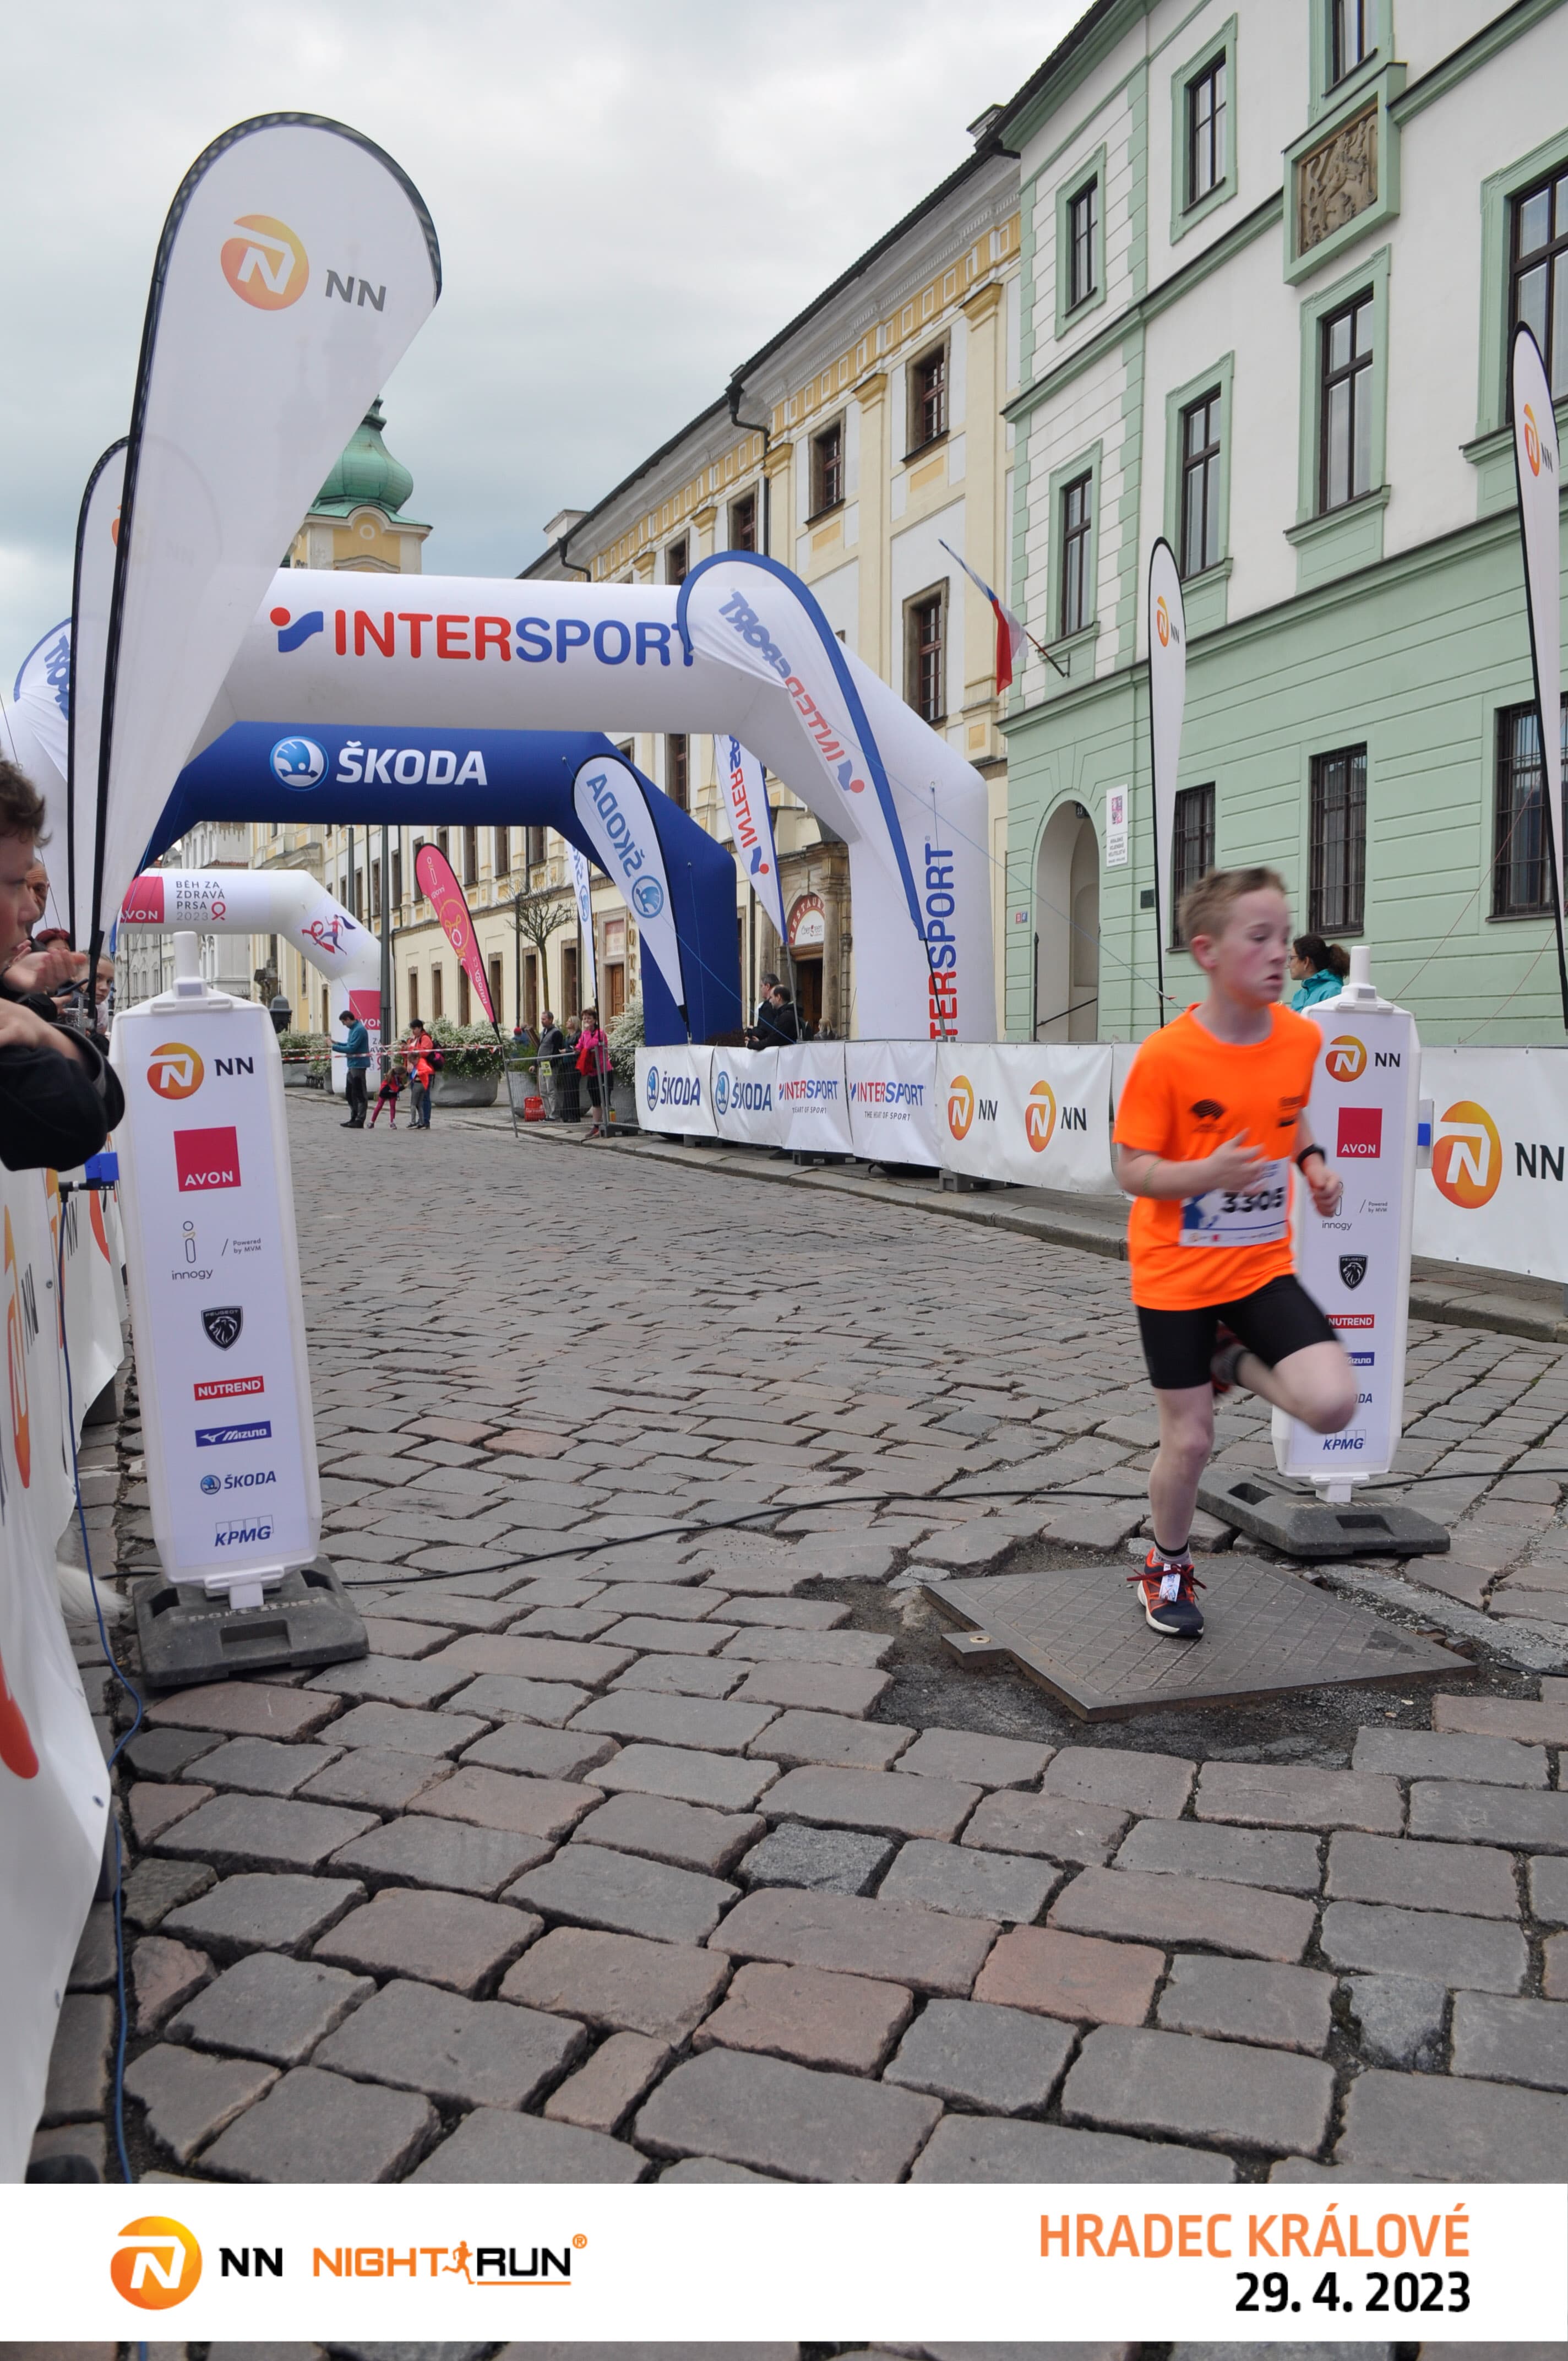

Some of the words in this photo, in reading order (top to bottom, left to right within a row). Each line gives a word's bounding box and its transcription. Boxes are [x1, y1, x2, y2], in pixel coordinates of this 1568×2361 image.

[325, 269, 387, 312] NN
[335, 739, 488, 786] ŠKODA
[176, 880, 199, 889] BĚH
[176, 889, 225, 899] ZDRAVÁ
[177, 901, 207, 910] PRSA
[176, 912, 208, 921] 2023
[925, 842, 959, 1039] TERSPORT
[214, 1057, 254, 1076] NN
[1374, 1052, 1401, 1068] NN
[660, 1071, 701, 1106] ŠKODA
[731, 1076, 772, 1112] ŠKODA
[785, 1080, 838, 1100] INTERSPORT
[857, 1081, 924, 1106] INTERSPORT
[890, 1112, 911, 1121] SPORT
[978, 1099, 998, 1121] NN
[1061, 1106, 1087, 1131] NN
[1341, 1144, 1376, 1154] AVON
[1515, 1141, 1565, 1182] NN
[185, 1171, 233, 1187] AVON
[1322, 1220, 1352, 1231] innogy
[233, 1238, 262, 1246] Powered
[172, 1269, 213, 1281] innogy
[205, 1309, 239, 1317] PEUGEOT
[1329, 1317, 1373, 1326] NUTREND
[198, 1379, 261, 1397] NUTREND
[1322, 1438, 1364, 1450] KPMG
[224, 1470, 276, 1489] ŠKODA
[215, 1525, 271, 1547] KPMG
